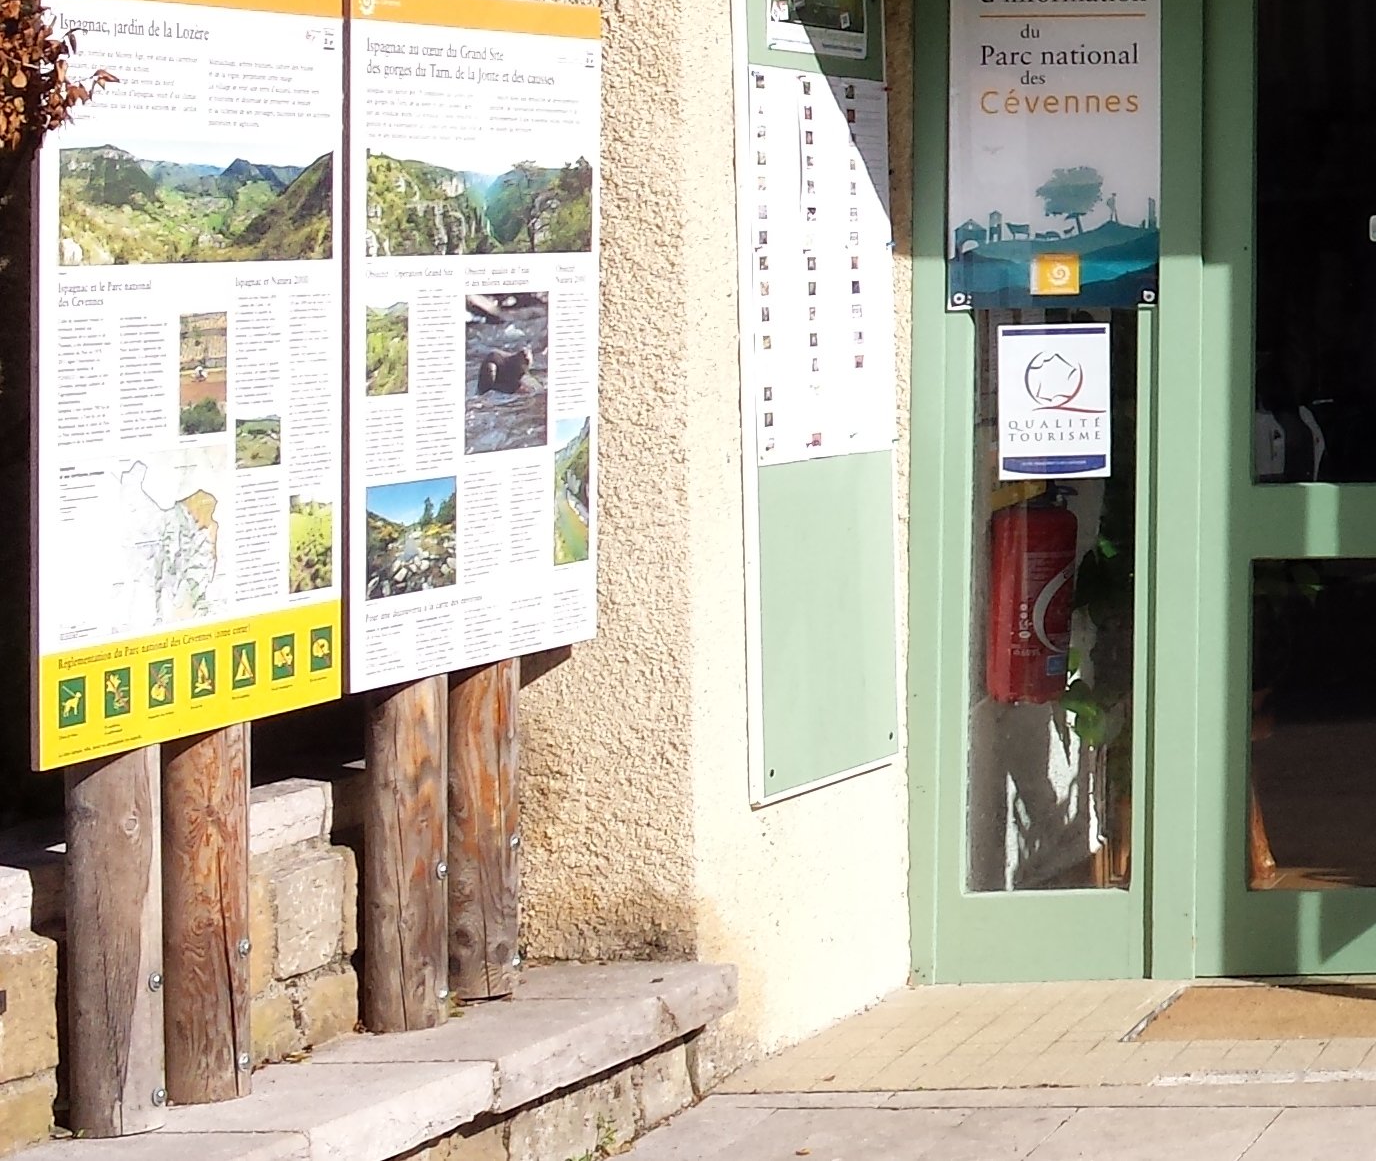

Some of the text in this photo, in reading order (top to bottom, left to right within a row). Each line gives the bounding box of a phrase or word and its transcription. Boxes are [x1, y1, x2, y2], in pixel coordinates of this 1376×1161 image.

[114, 19, 144, 36] jardin
[148, 20, 160, 37] de
[164, 21, 172, 38] la
[1020, 23, 1040, 39] du
[366, 37, 406, 57] Ispagnac
[446, 43, 457, 58] du
[460, 44, 487, 60] Grand
[980, 42, 1139, 65] Parc national
[366, 59, 381, 75] des
[384, 65, 412, 80] gorges
[415, 62, 427, 77] du
[1020, 70, 1046, 85] des
[980, 88, 1140, 114] Cévennes
[1008, 417, 1101, 432] QUALITÉ
[1008, 430, 1101, 442] TOURISME
